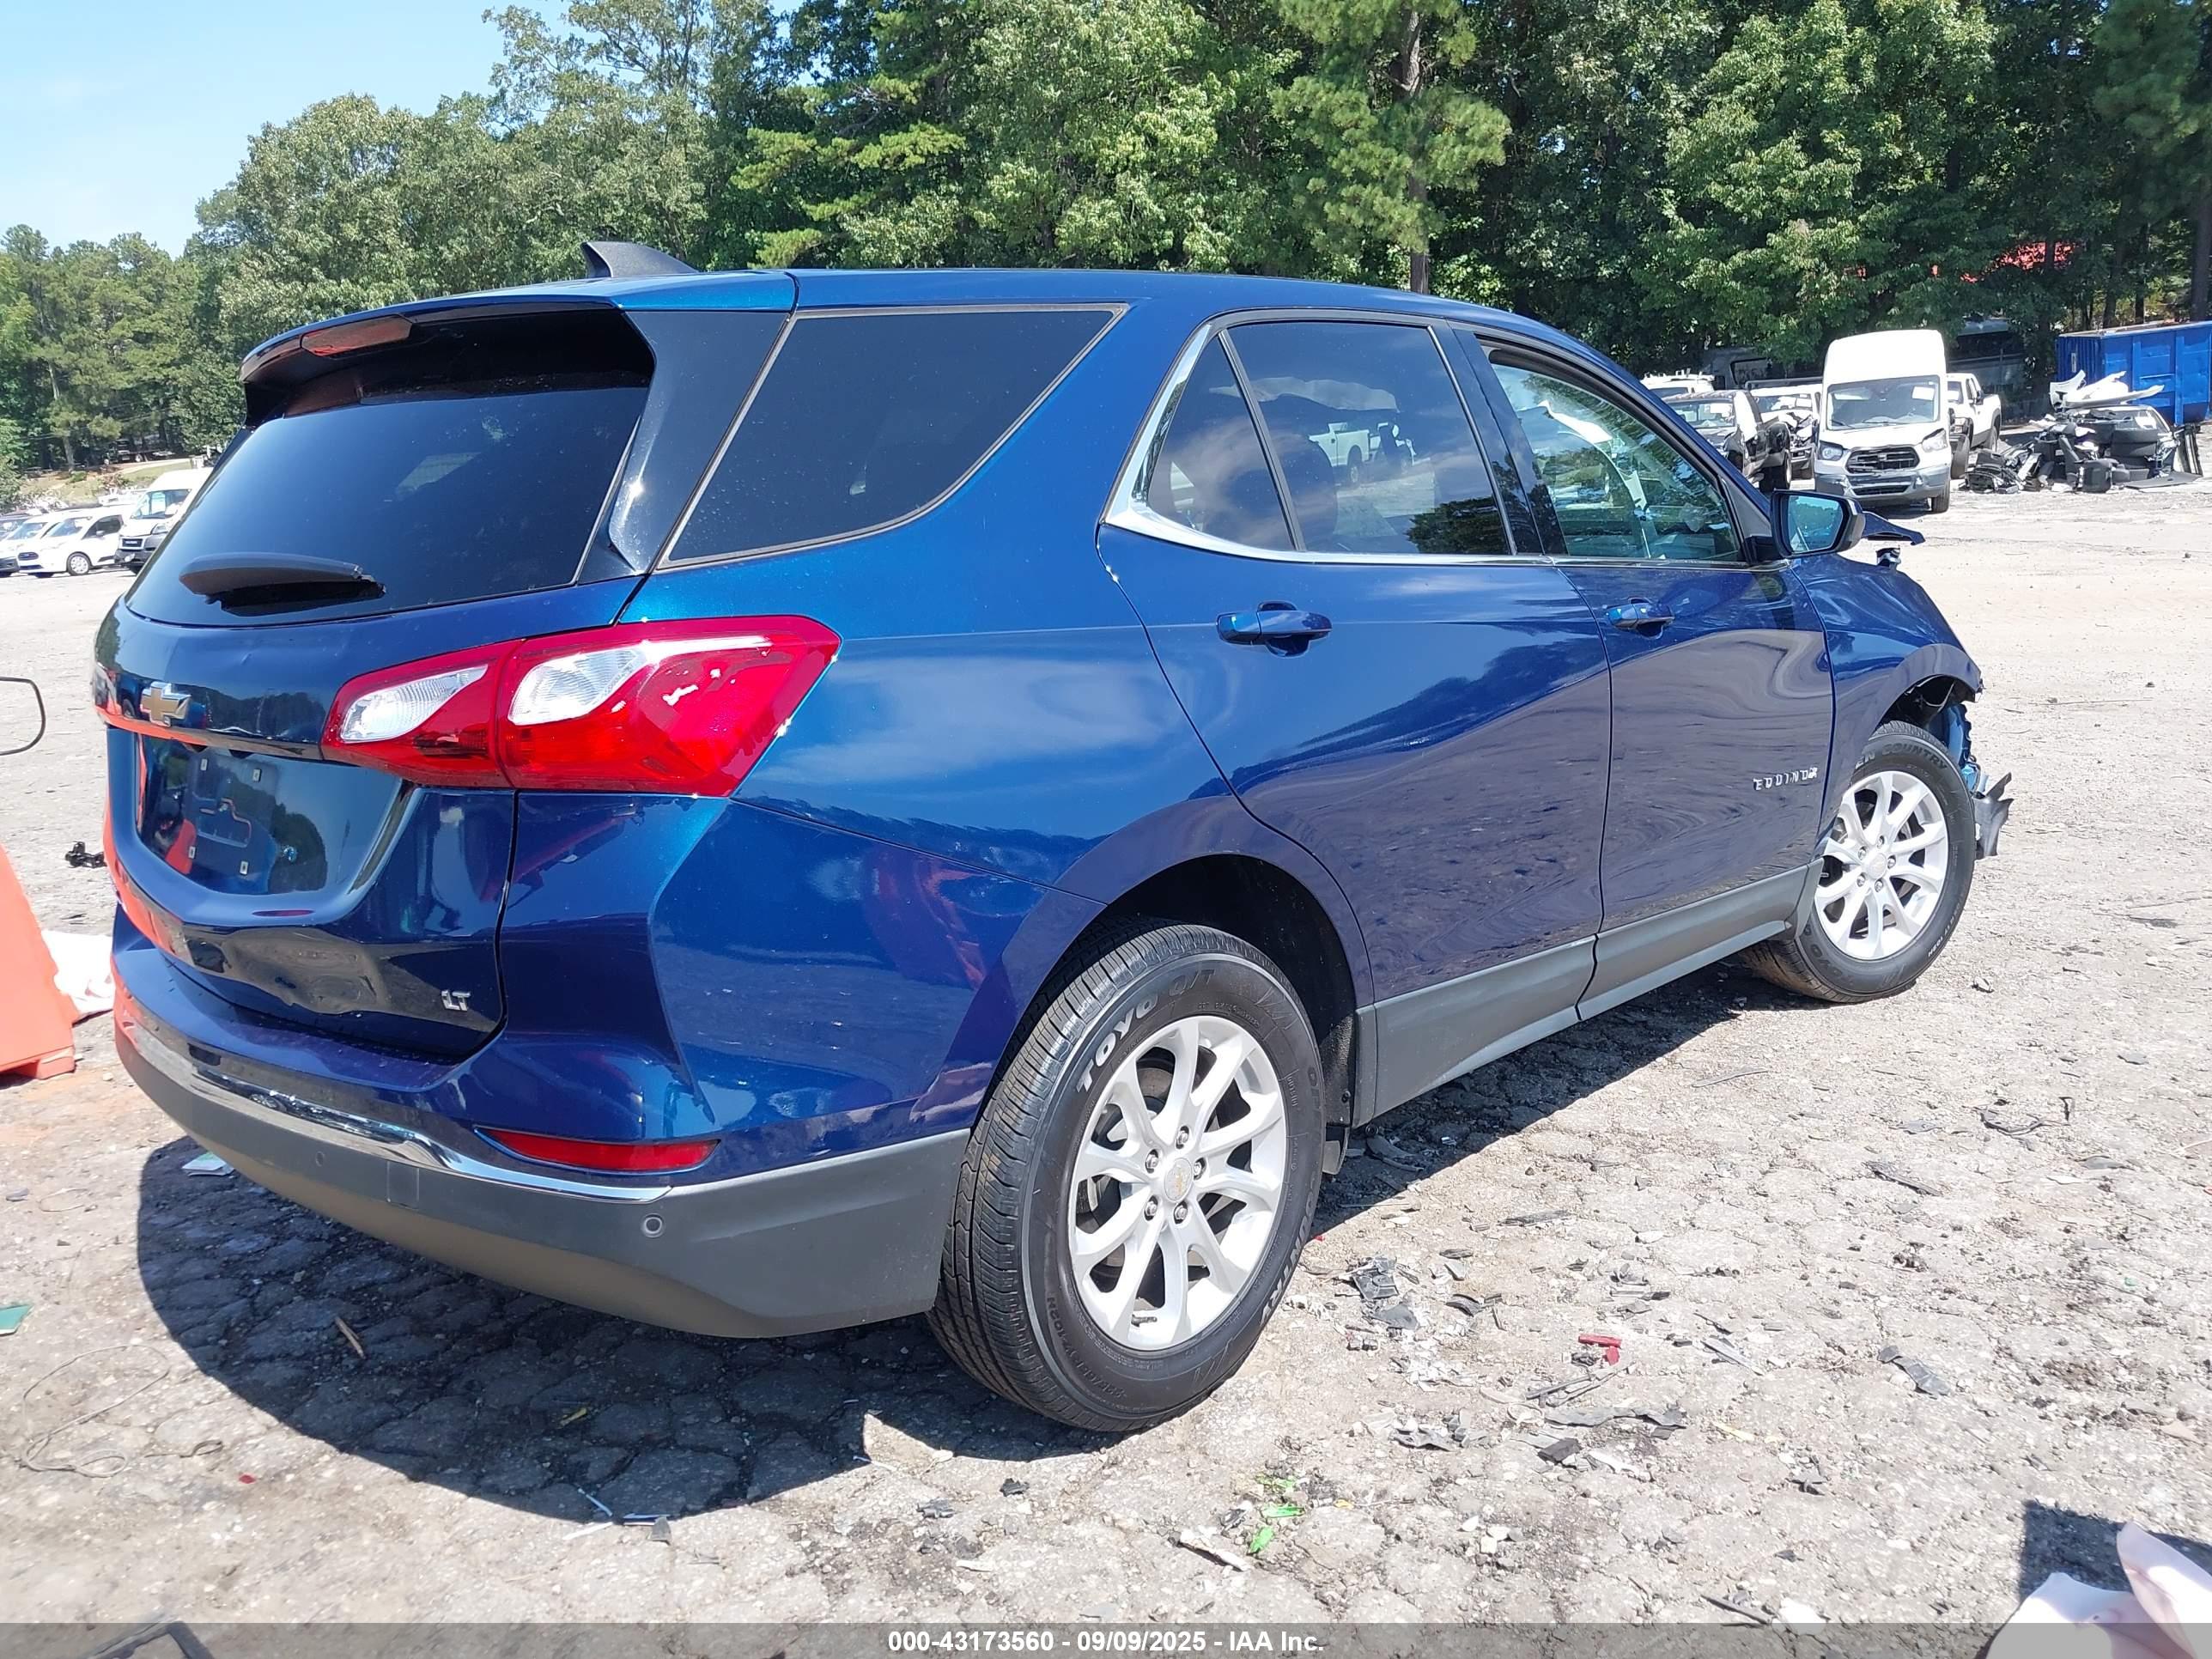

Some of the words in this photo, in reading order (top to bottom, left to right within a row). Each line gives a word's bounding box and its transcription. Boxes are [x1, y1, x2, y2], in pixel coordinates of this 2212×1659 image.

[1882, 743, 1948, 769] COUNTRY
[441, 989, 471, 1012] LT
[1076, 995, 1158, 1093] TOYO
